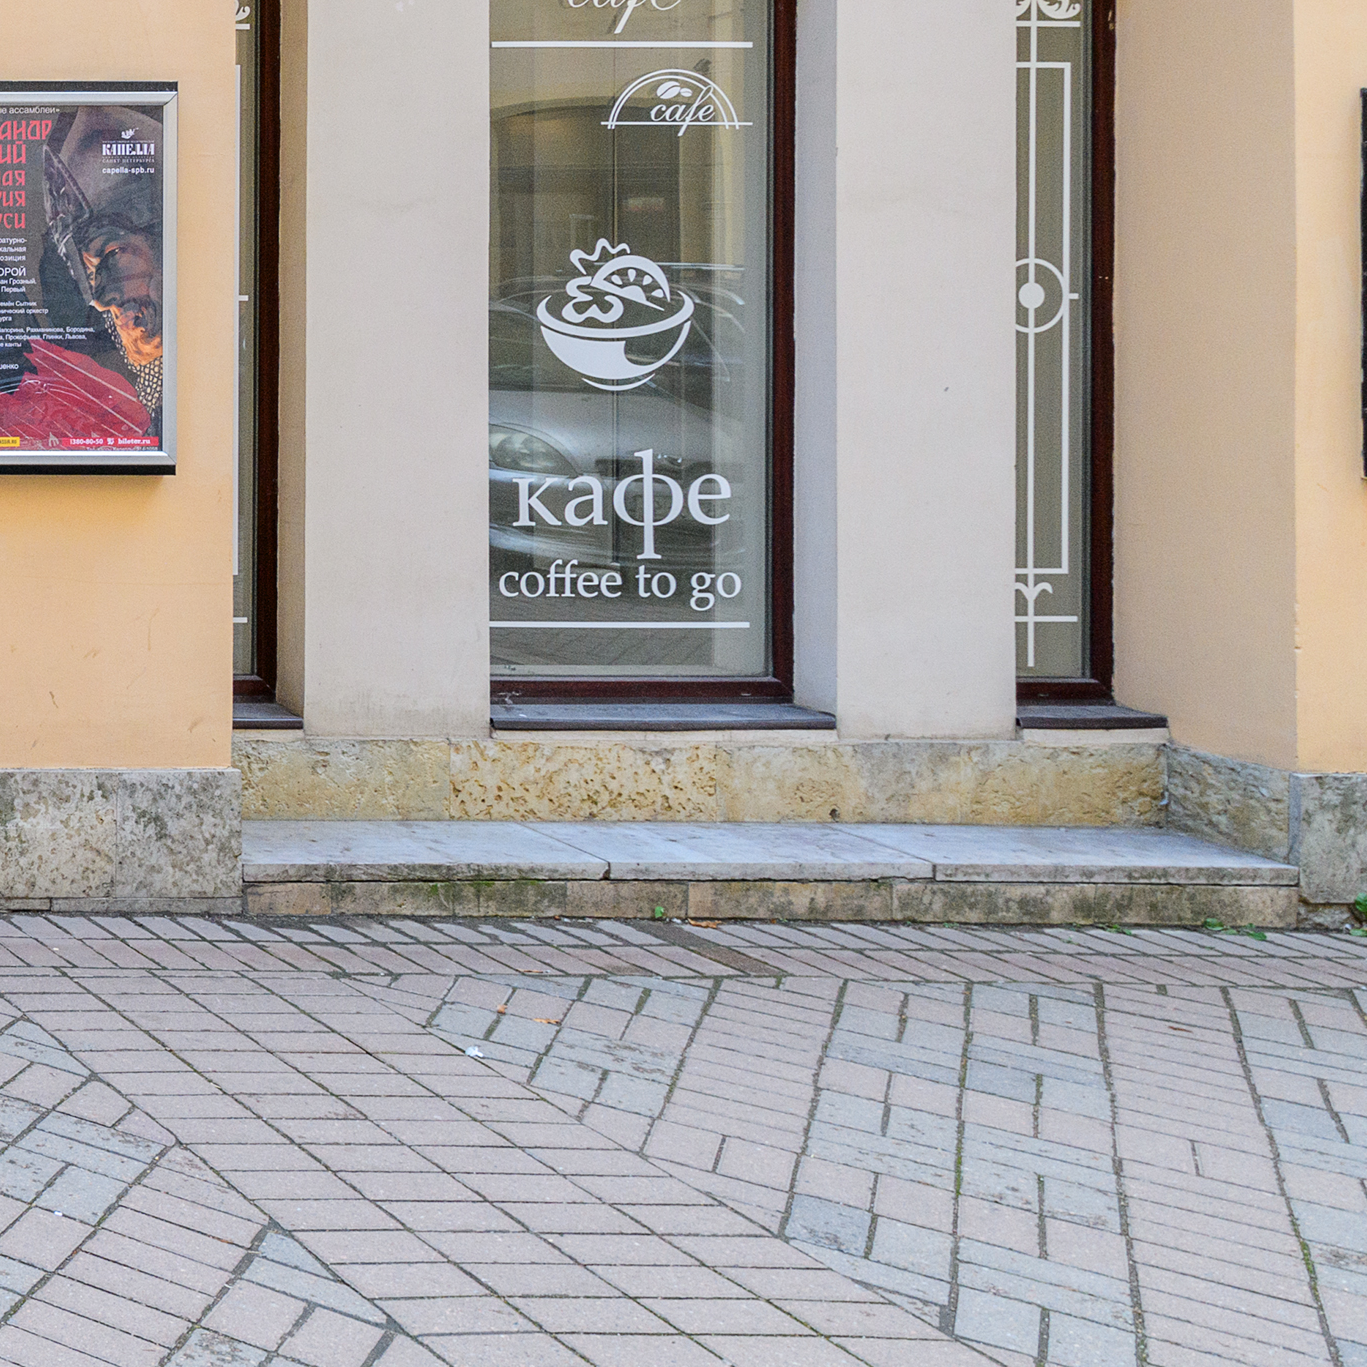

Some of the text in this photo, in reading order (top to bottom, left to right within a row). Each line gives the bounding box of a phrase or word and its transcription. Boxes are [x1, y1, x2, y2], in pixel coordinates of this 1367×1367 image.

[9, 105, 60, 115] ассамблеи»
[650, 85, 715, 137] cafe
[102, 144, 155, 155] КАПЕЛЛА
[102, 167, 155, 175] capella-spb.ru
[511, 449, 731, 560] кафе
[499, 559, 742, 611] coffee to go
